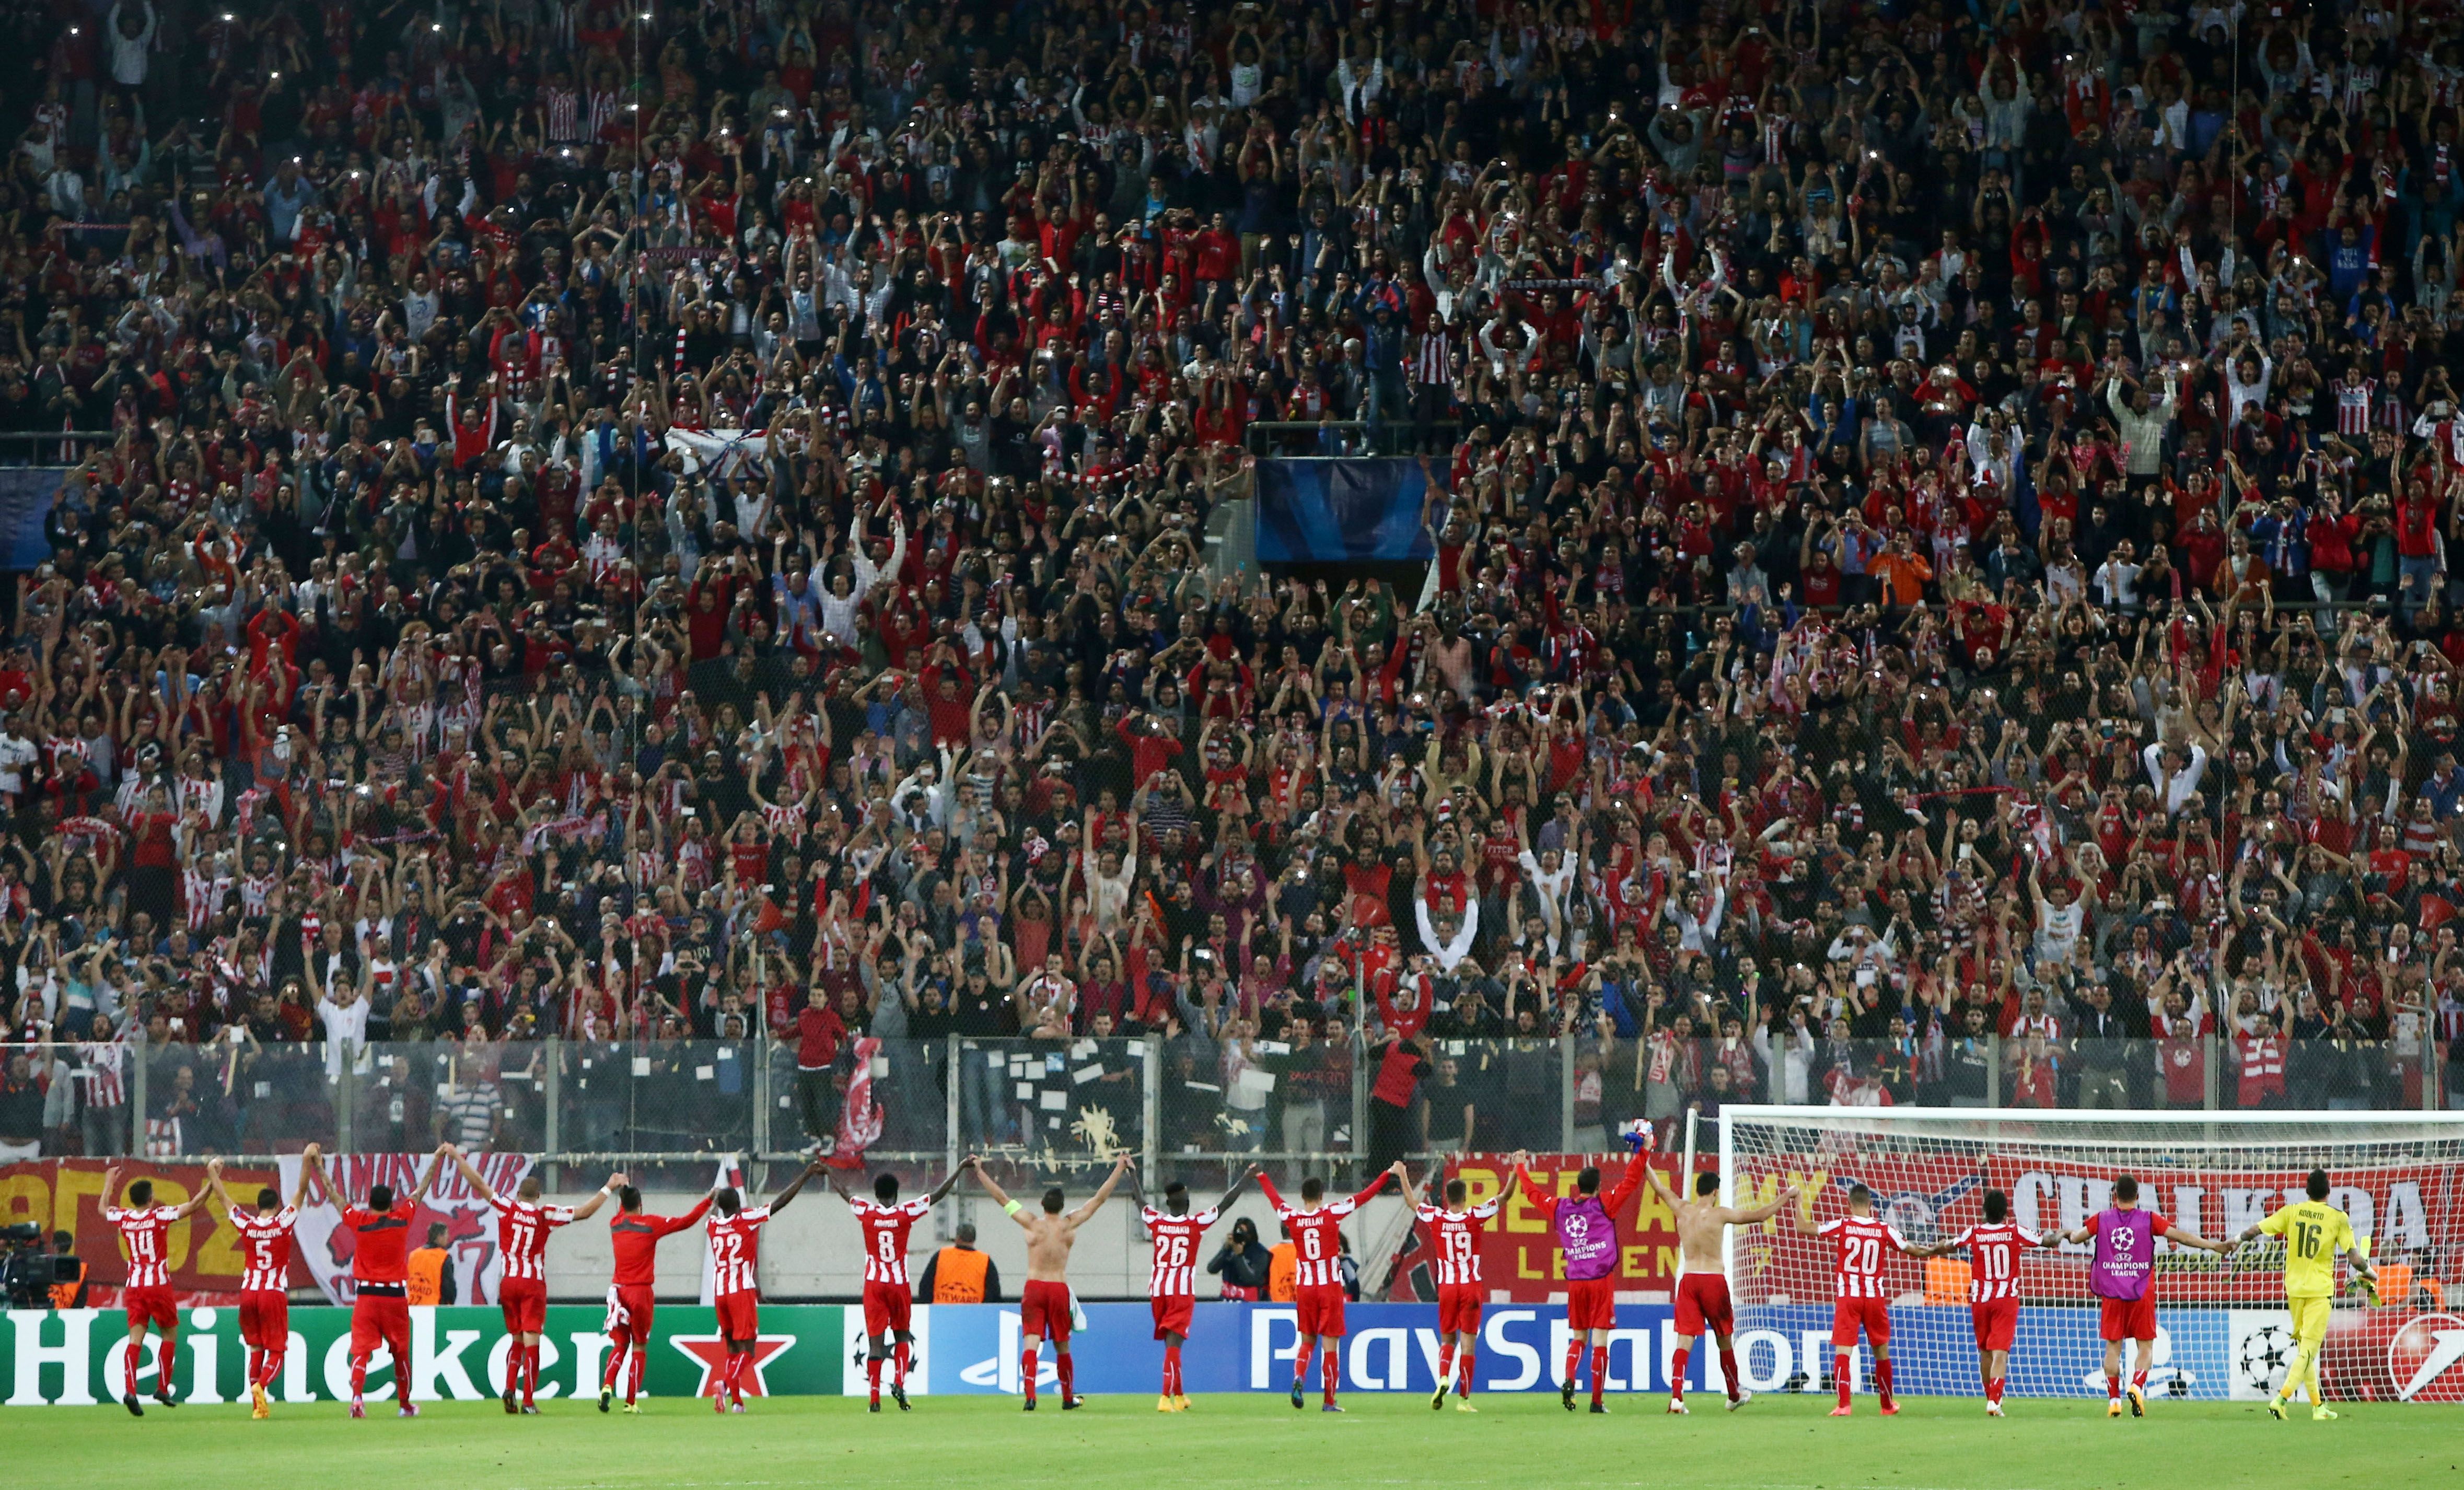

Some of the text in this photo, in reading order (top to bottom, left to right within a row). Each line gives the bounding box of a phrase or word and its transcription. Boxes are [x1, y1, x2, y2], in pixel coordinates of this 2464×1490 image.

[1157, 1224, 1190, 1235] MASUAKU
[1296, 1216, 1324, 1228] AFELLAY
[1442, 1223, 1467, 1231] FUSTER
[2299, 1209, 2324, 1220] ROBERTO
[125, 1229, 156, 1263] 14
[510, 1223, 536, 1257] 11
[878, 1230, 896, 1263] 8
[1304, 1228, 1321, 1261] 6
[1440, 1231, 1472, 1263] 19
[1845, 1225, 1882, 1238] GIANNOULIS
[1975, 1231, 2013, 1243] DOMINGUEZ
[2295, 1221, 2322, 1260] 16
[255, 1239, 272, 1270] 5
[712, 1233, 743, 1267] 22
[1156, 1235, 1190, 1268] 26
[1843, 1236, 1880, 1275] 20
[1979, 1243, 2010, 1280] 10
[2102, 1261, 2149, 1270] CHAMPIONS
[2111, 1270, 2140, 1278] LEAGUE
[5, 1306, 648, 1405] Heineken
